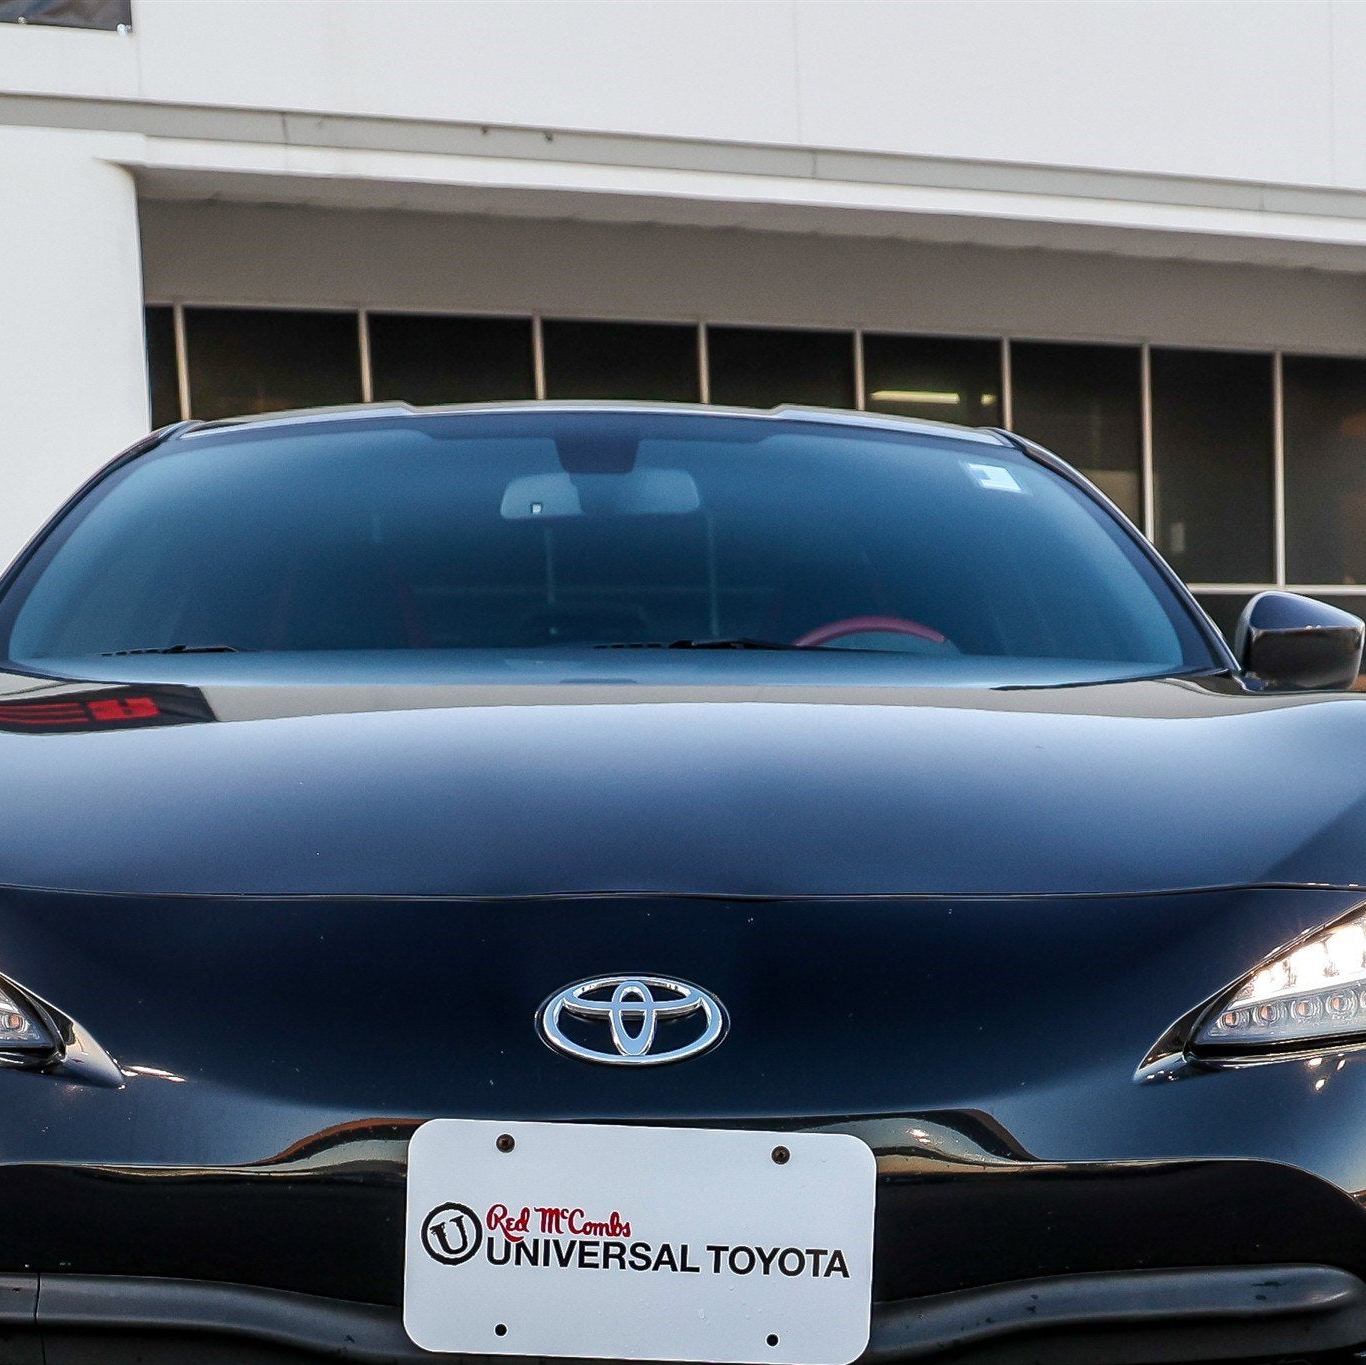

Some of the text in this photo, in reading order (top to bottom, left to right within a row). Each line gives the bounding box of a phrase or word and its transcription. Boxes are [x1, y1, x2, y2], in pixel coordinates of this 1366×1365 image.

[486, 1204, 631, 1243] Red McCombs
[487, 1237, 850, 1279] UNIVERSAL TOYOTA
